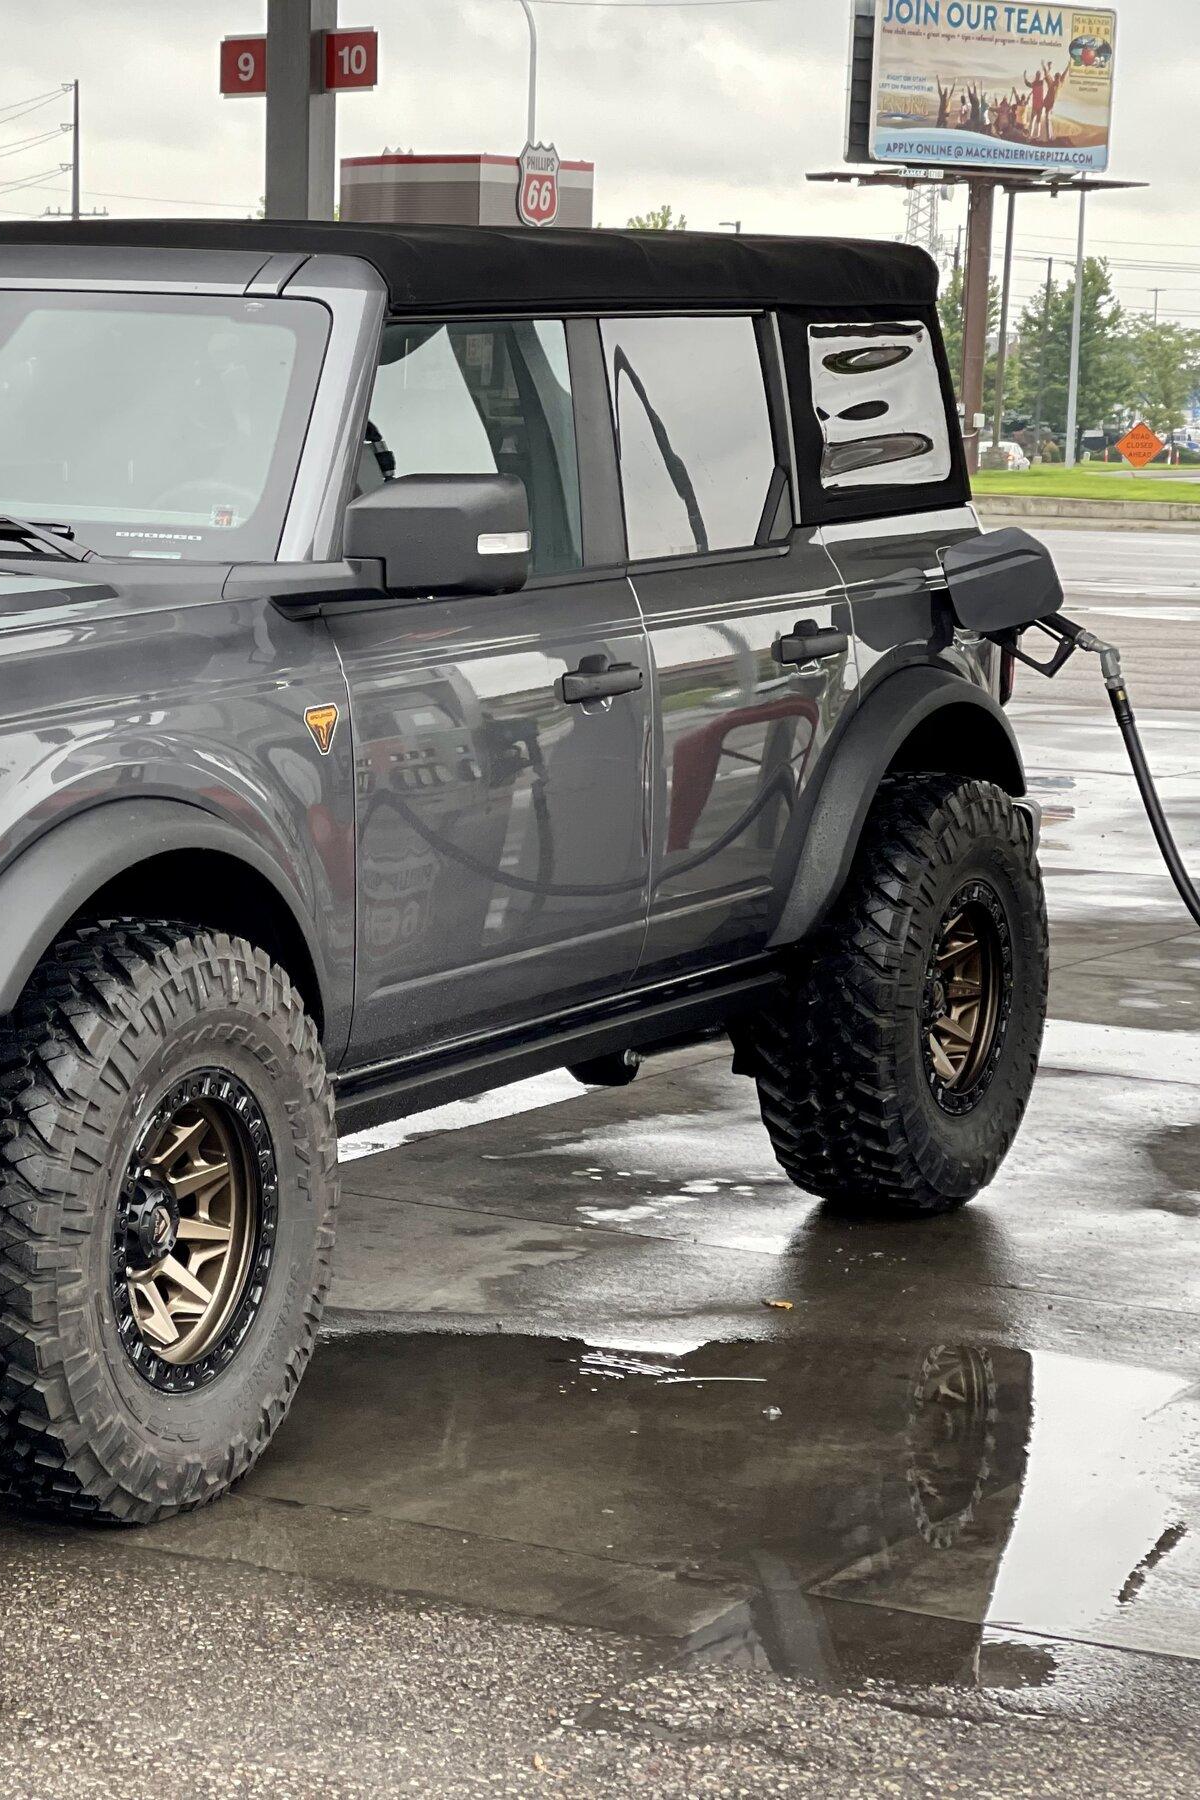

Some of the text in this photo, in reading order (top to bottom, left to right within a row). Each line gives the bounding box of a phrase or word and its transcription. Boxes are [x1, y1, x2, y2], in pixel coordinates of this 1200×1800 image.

[883, 0, 1063, 36] JOIN OUR TEAM
[236, 52, 255, 82] 9
[338, 45, 367, 75] 10
[526, 155, 555, 172] PHILLIPS
[886, 142, 1093, 164] APPLY ONLINE @ MACKENZIERIVERPIZZA.COM
[527, 179, 552, 211] 66
[116, 531, 202, 541] BRONCO
